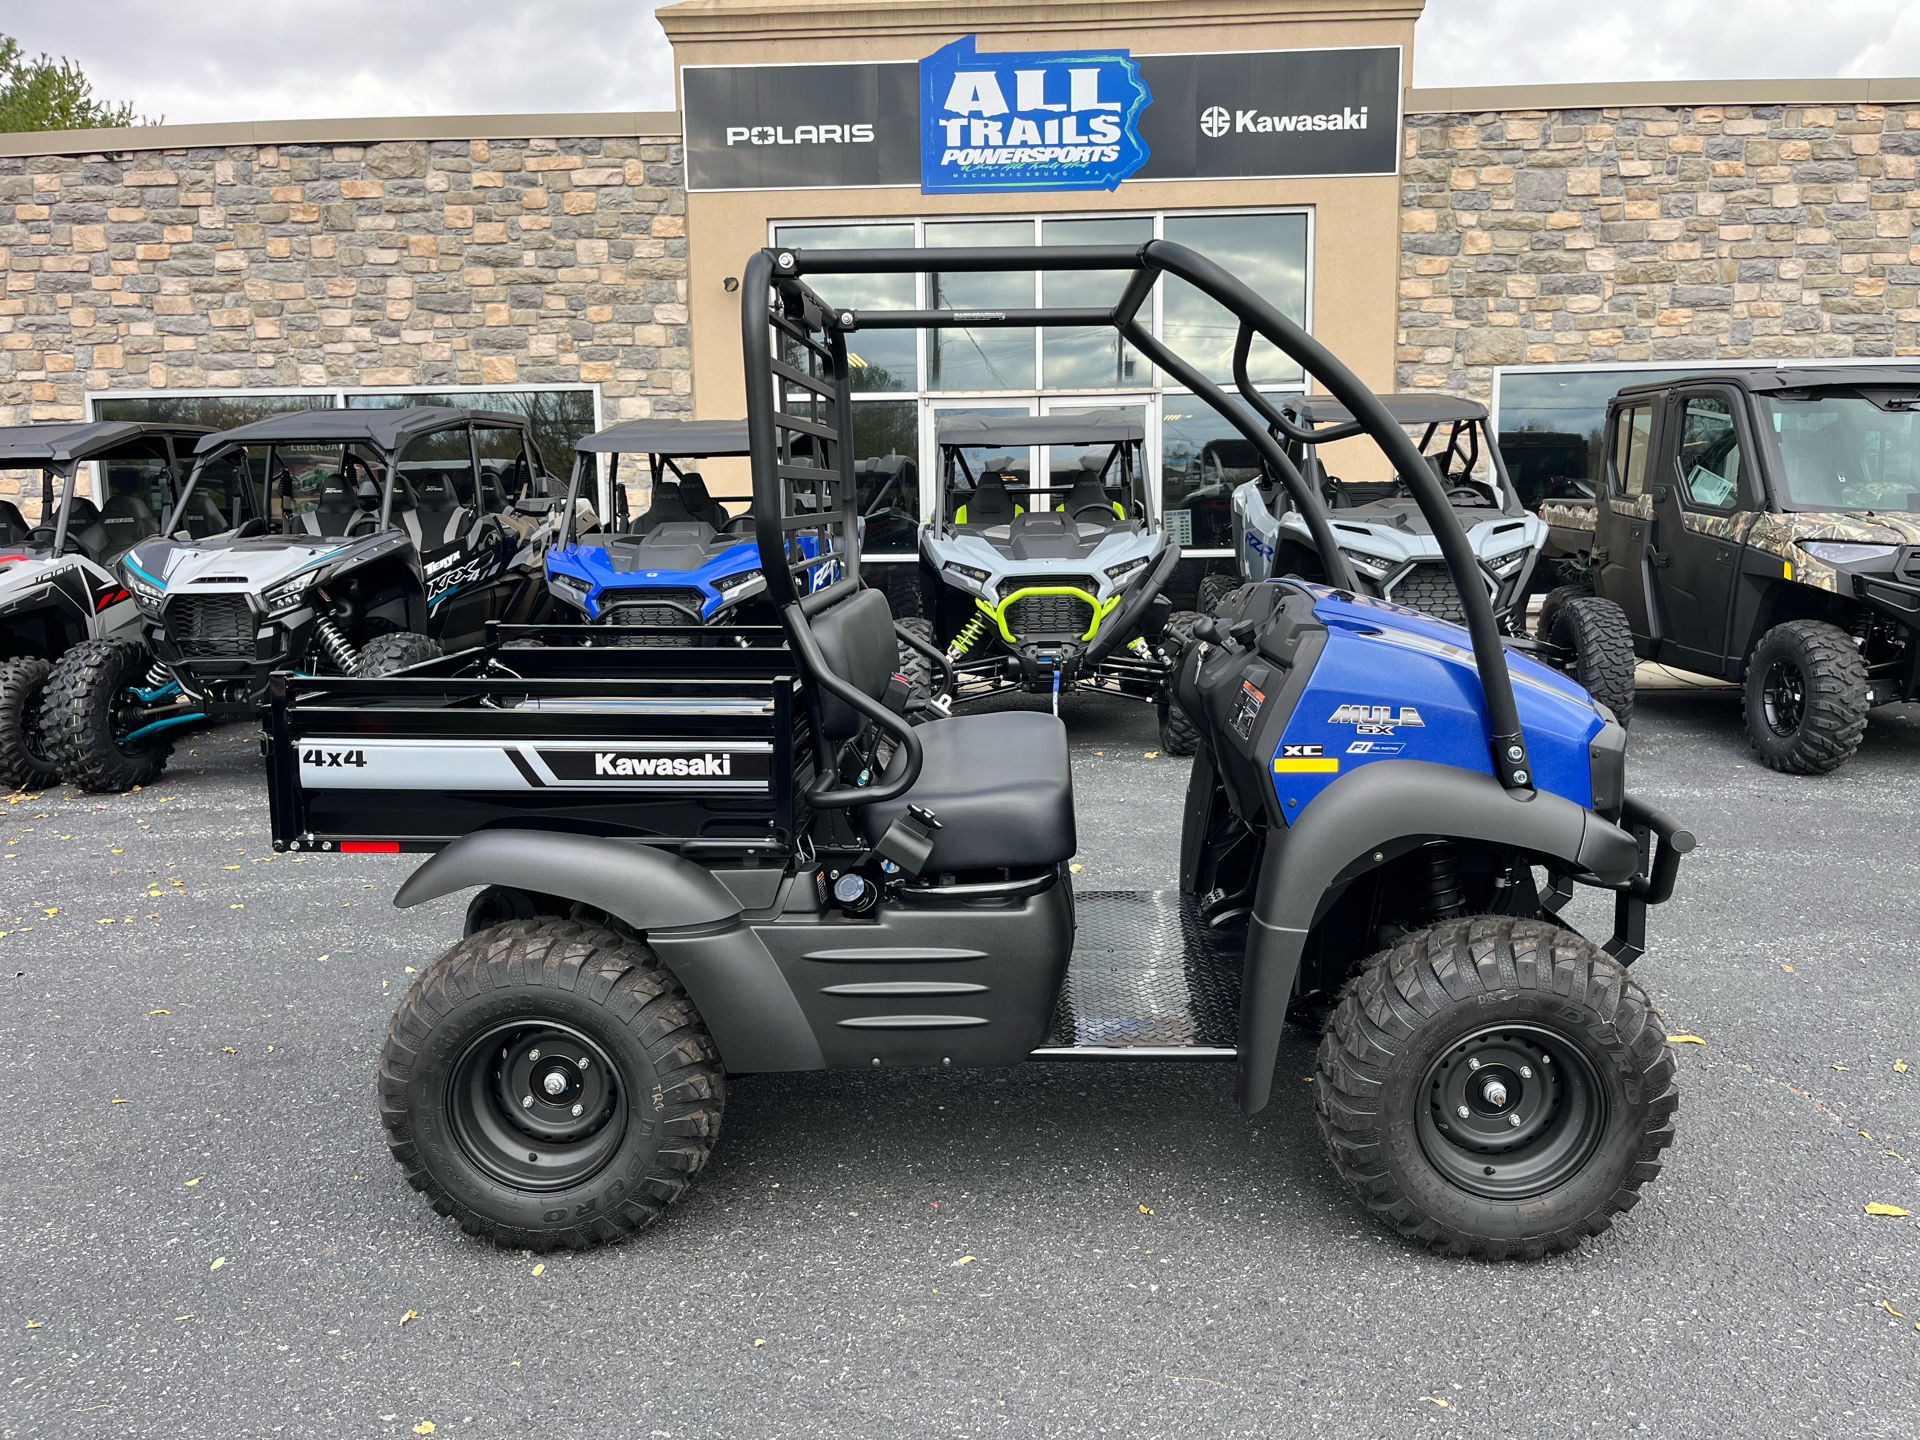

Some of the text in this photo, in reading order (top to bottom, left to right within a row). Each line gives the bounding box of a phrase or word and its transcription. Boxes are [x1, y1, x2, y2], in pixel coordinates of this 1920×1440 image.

[943, 68, 1121, 117] ALL
[1235, 106, 1368, 133] Kawasaki
[726, 124, 875, 146] POLARIS
[939, 115, 1122, 147] TRAILS
[940, 145, 1121, 166] POWERSPORTS
[1245, 531, 1274, 563] RZR
[1756, 531, 1782, 545] 1000
[1328, 704, 1425, 727] MULE
[1357, 725, 1395, 735] SX
[1283, 745, 1322, 756] XC
[1351, 743, 1370, 751] FI
[303, 750, 367, 767] 4x4
[595, 753, 731, 775] Kawasaki
[1554, 1005, 1643, 1106] DURO
[542, 1150, 646, 1225] DURO
